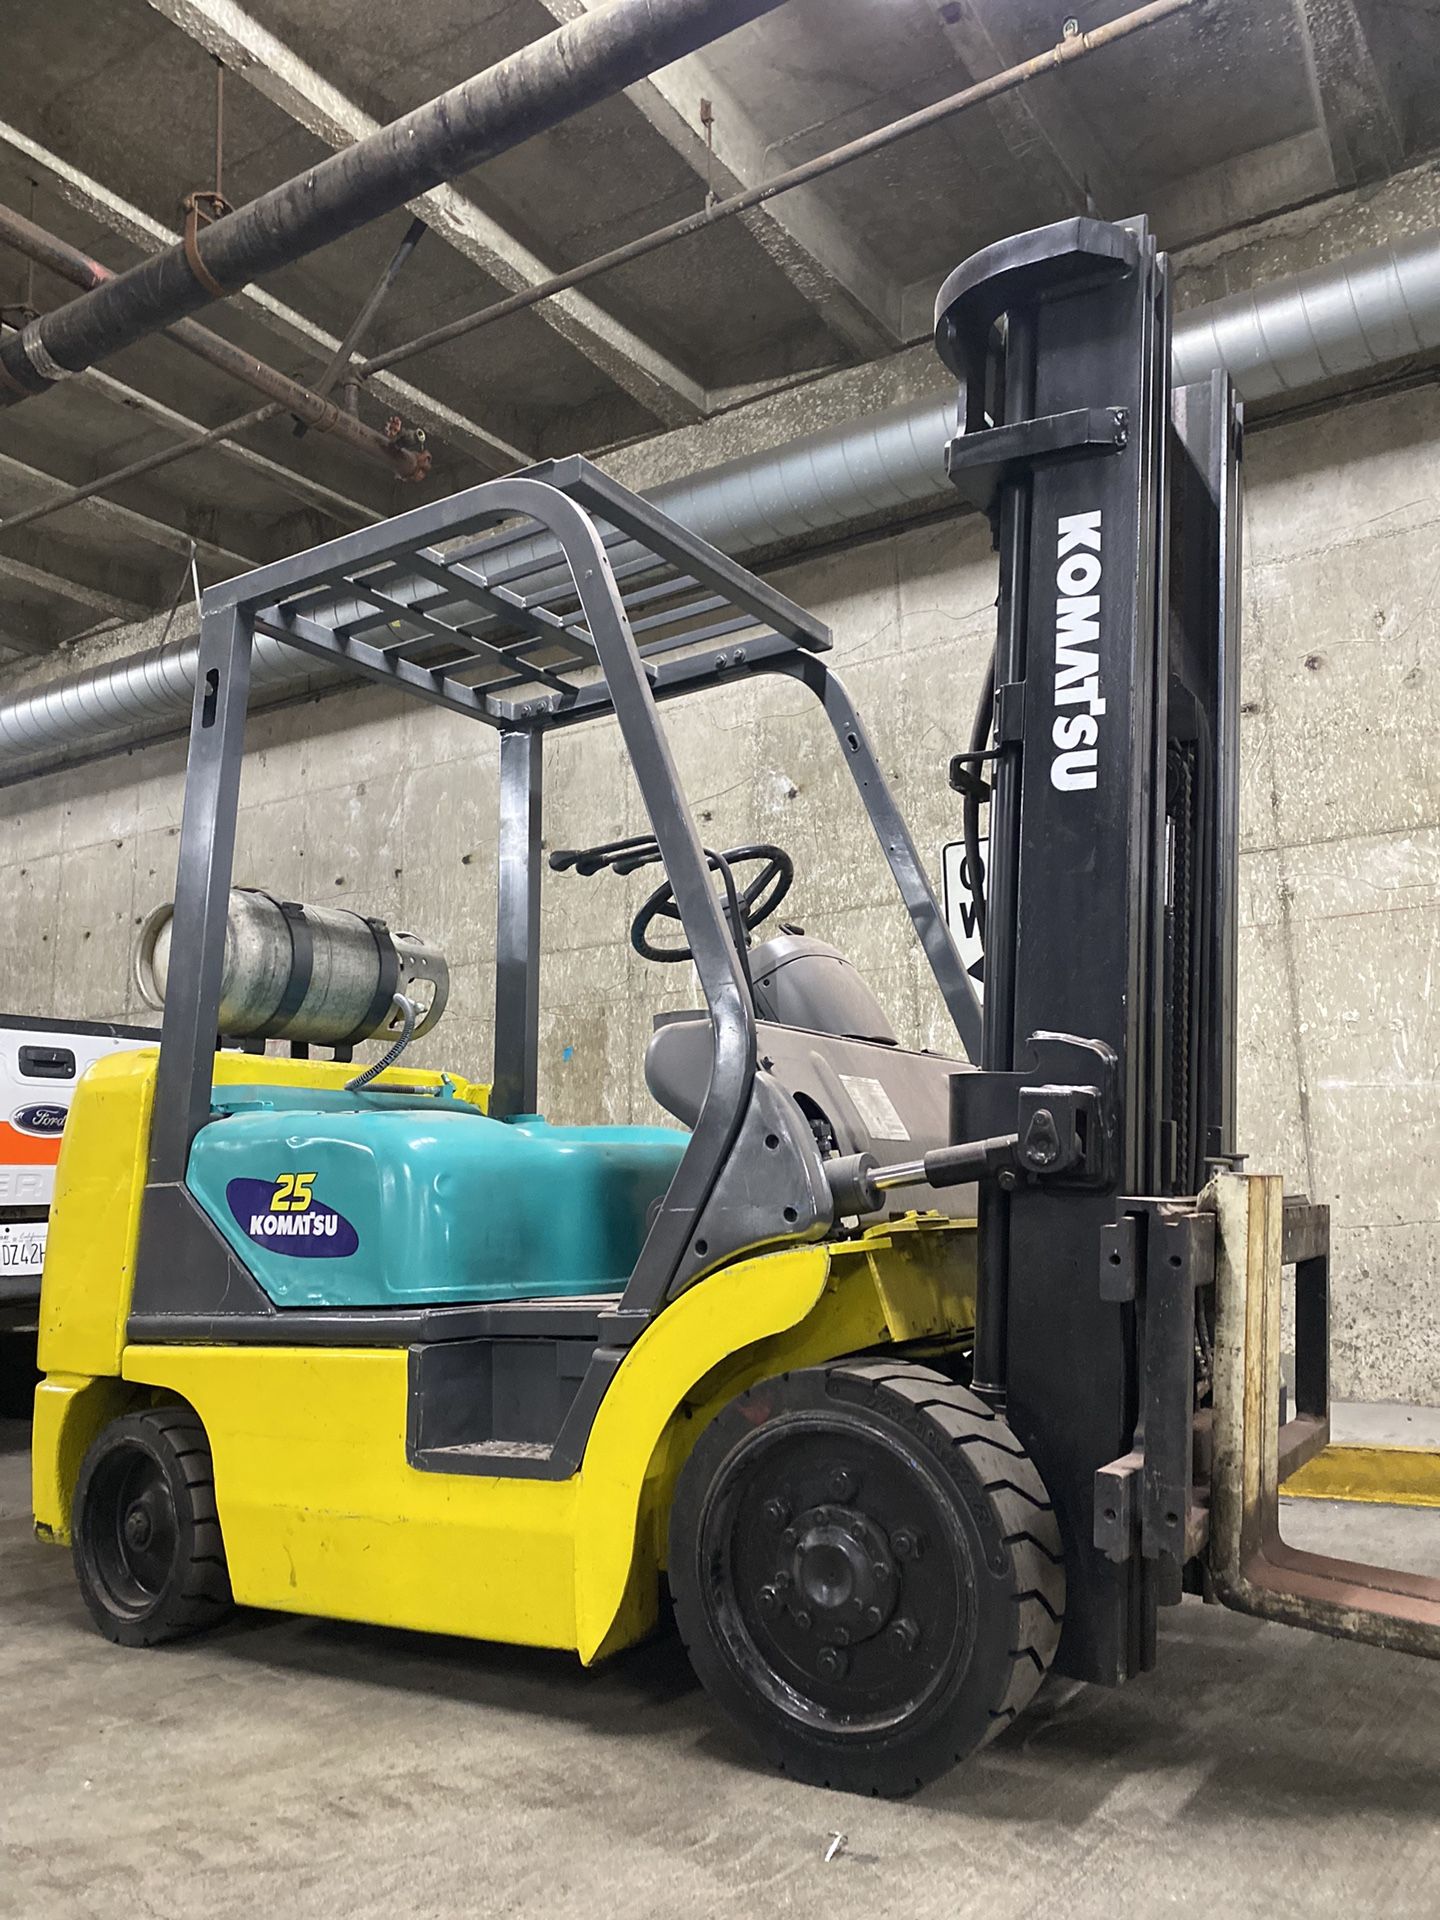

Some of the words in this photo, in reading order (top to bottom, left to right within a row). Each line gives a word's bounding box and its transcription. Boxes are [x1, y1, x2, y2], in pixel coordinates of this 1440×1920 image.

[1051, 510, 1106, 792] KOMATSU
[32, 1110, 67, 1125] Ford
[270, 1172, 318, 1211] 25
[250, 1212, 338, 1236] KOMATSU
